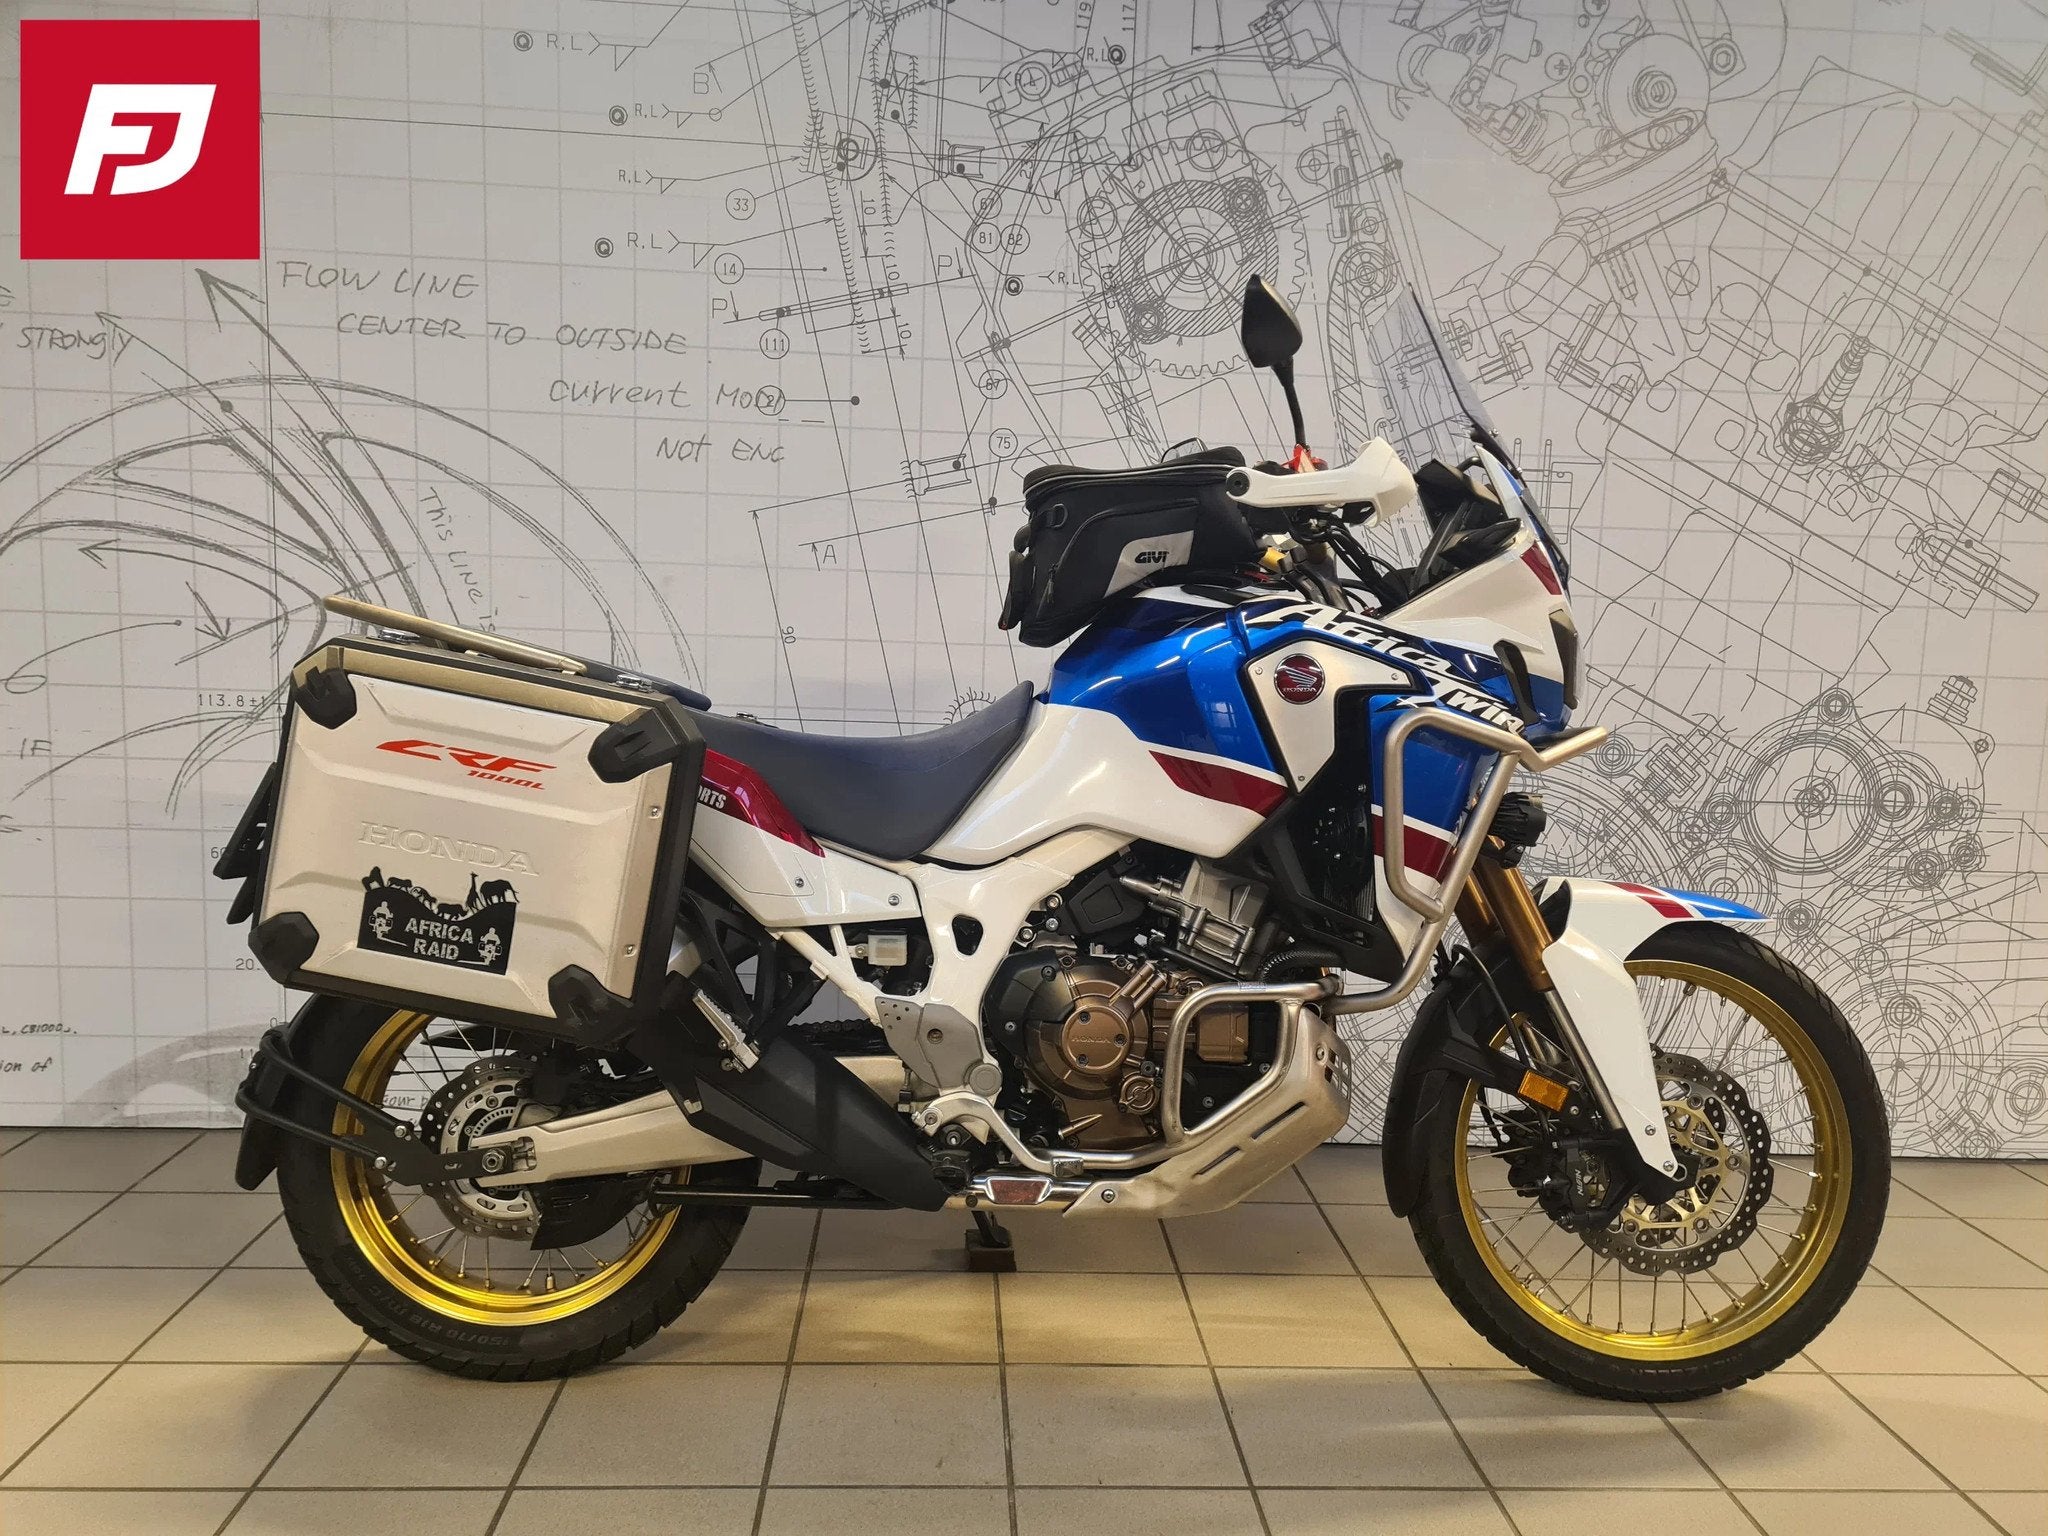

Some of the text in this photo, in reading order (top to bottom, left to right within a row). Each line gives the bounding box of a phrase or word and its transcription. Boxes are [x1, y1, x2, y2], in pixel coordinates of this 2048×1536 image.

[1076, 3, 1092, 30] 119
[693, 72, 710, 95] B
[732, 198, 750, 212] 33
[863, 199, 876, 215] 10
[979, 231, 993, 245] 81
[1007, 234, 1023, 246] 82
[722, 262, 737, 276] 14
[886, 263, 900, 281] 10
[937, 254, 953, 276] P
[277, 260, 480, 299] FLOW LINE
[712, 297, 728, 319] P
[337, 312, 687, 355] CENTER TO OUTSIDE
[897, 322, 912, 340] 10
[764, 337, 786, 351] 111
[996, 436, 1010, 449] 75
[822, 544, 837, 564] A
[1134, 550, 1169, 564] GIVI
[782, 625, 796, 645] 90
[376, 739, 558, 773] CRF
[467, 769, 546, 791] 1000L
[357, 820, 540, 877] HONDA
[405, 917, 475, 945] AFRICA
[413, 938, 461, 961] RAID
